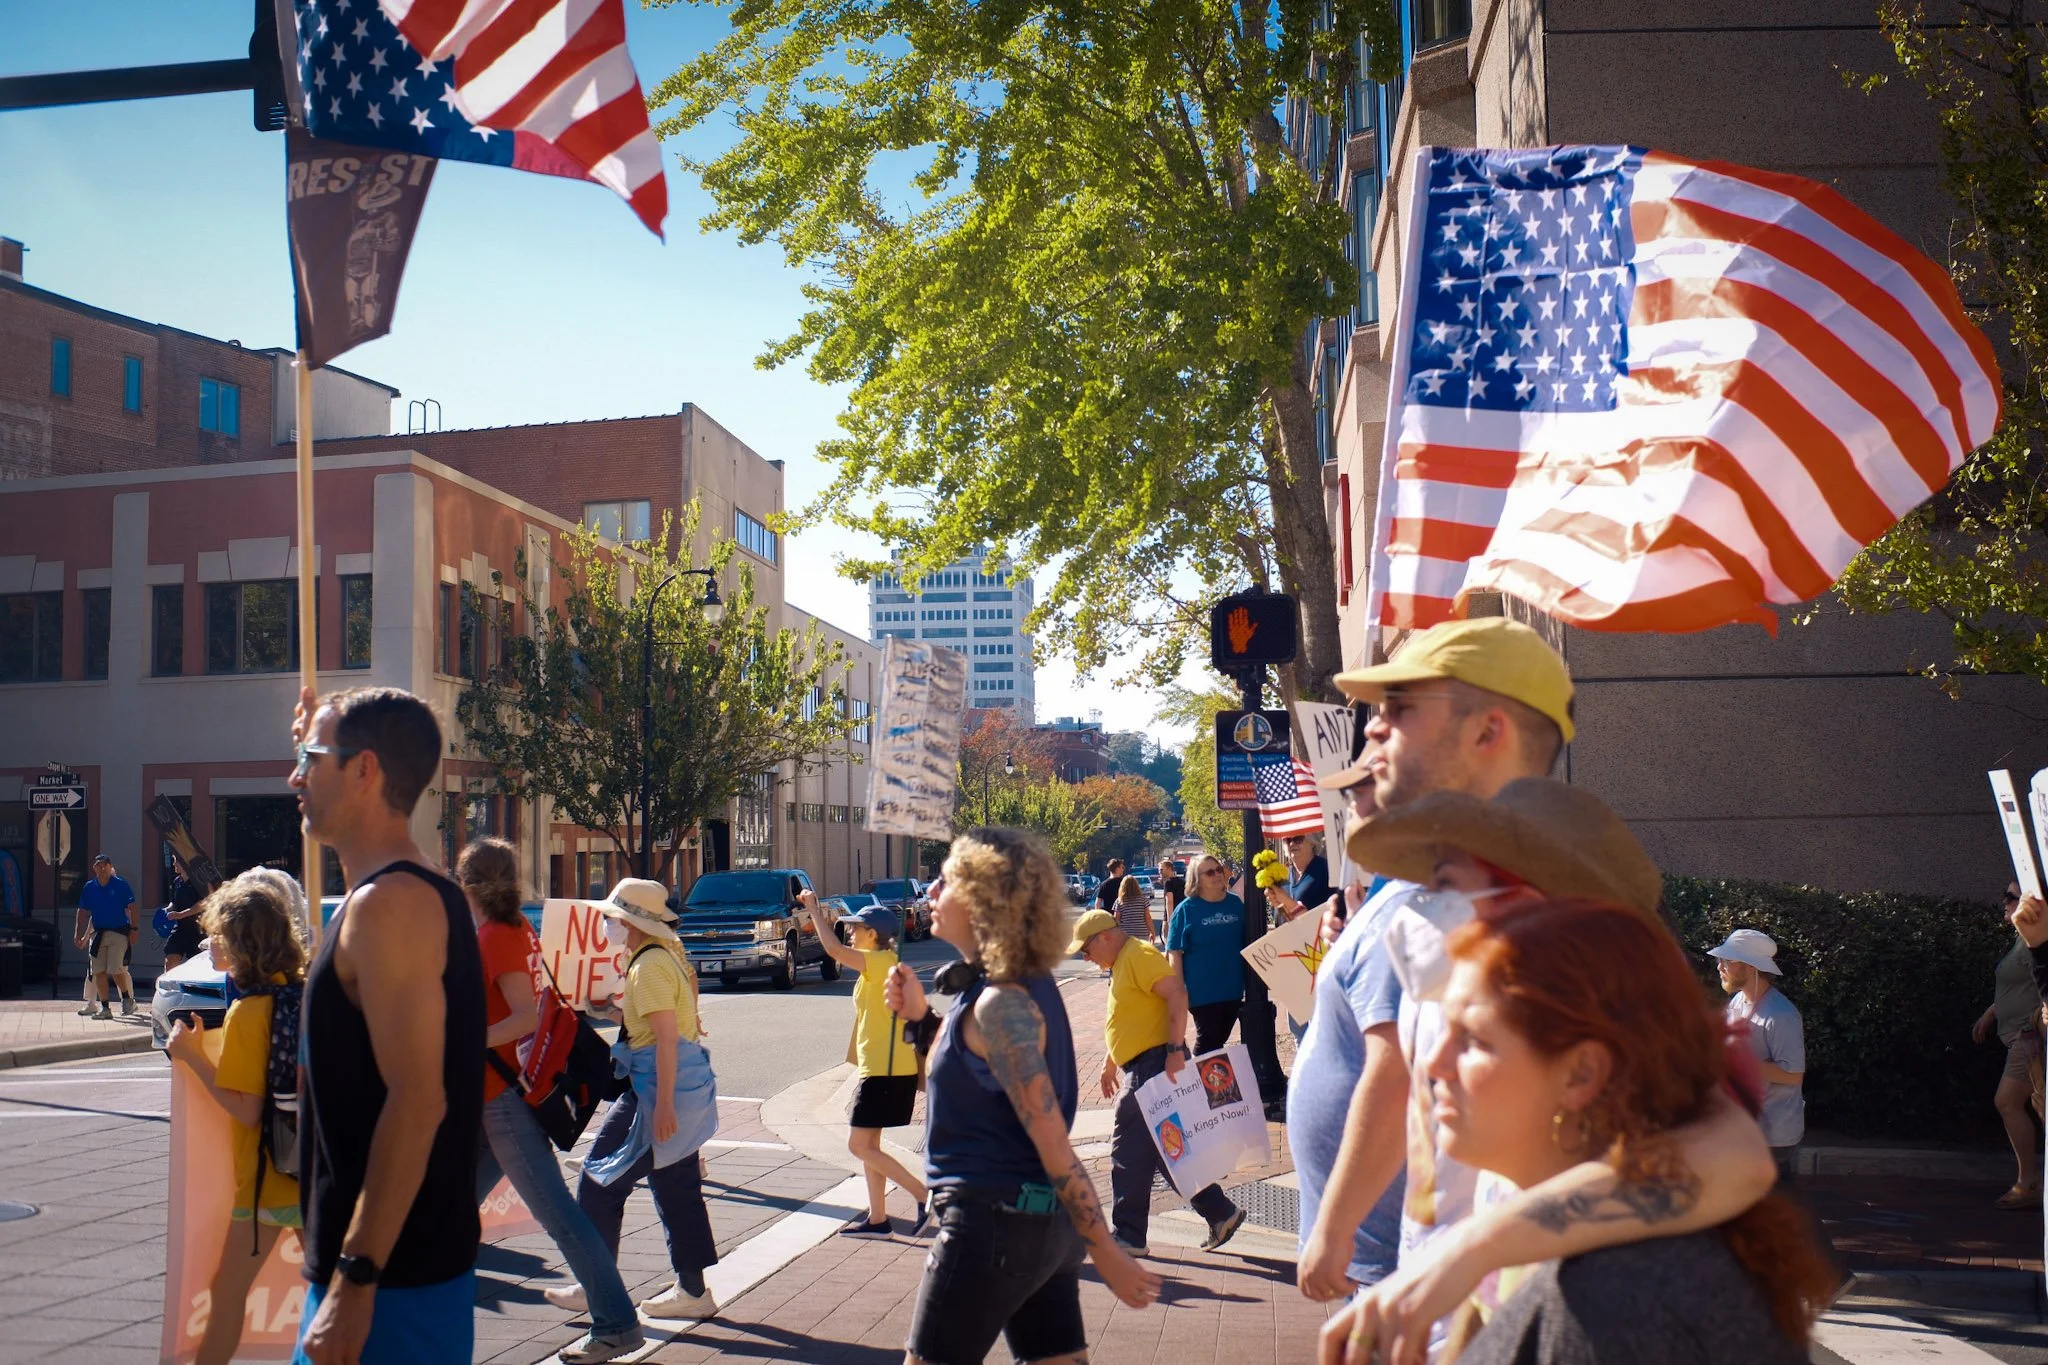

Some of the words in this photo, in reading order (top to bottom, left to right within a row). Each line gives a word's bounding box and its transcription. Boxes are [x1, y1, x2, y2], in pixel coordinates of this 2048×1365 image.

[288, 154, 433, 202] RESST
[40, 775, 63, 785] Market
[35, 794, 50, 803] ONE
[52, 794, 68, 803] WAY
[1252, 942, 1278, 972] NO
[1154, 1094, 1173, 1111] Kings
[1181, 1129, 1194, 1141] No
[1193, 1115, 1219, 1133] Kings
